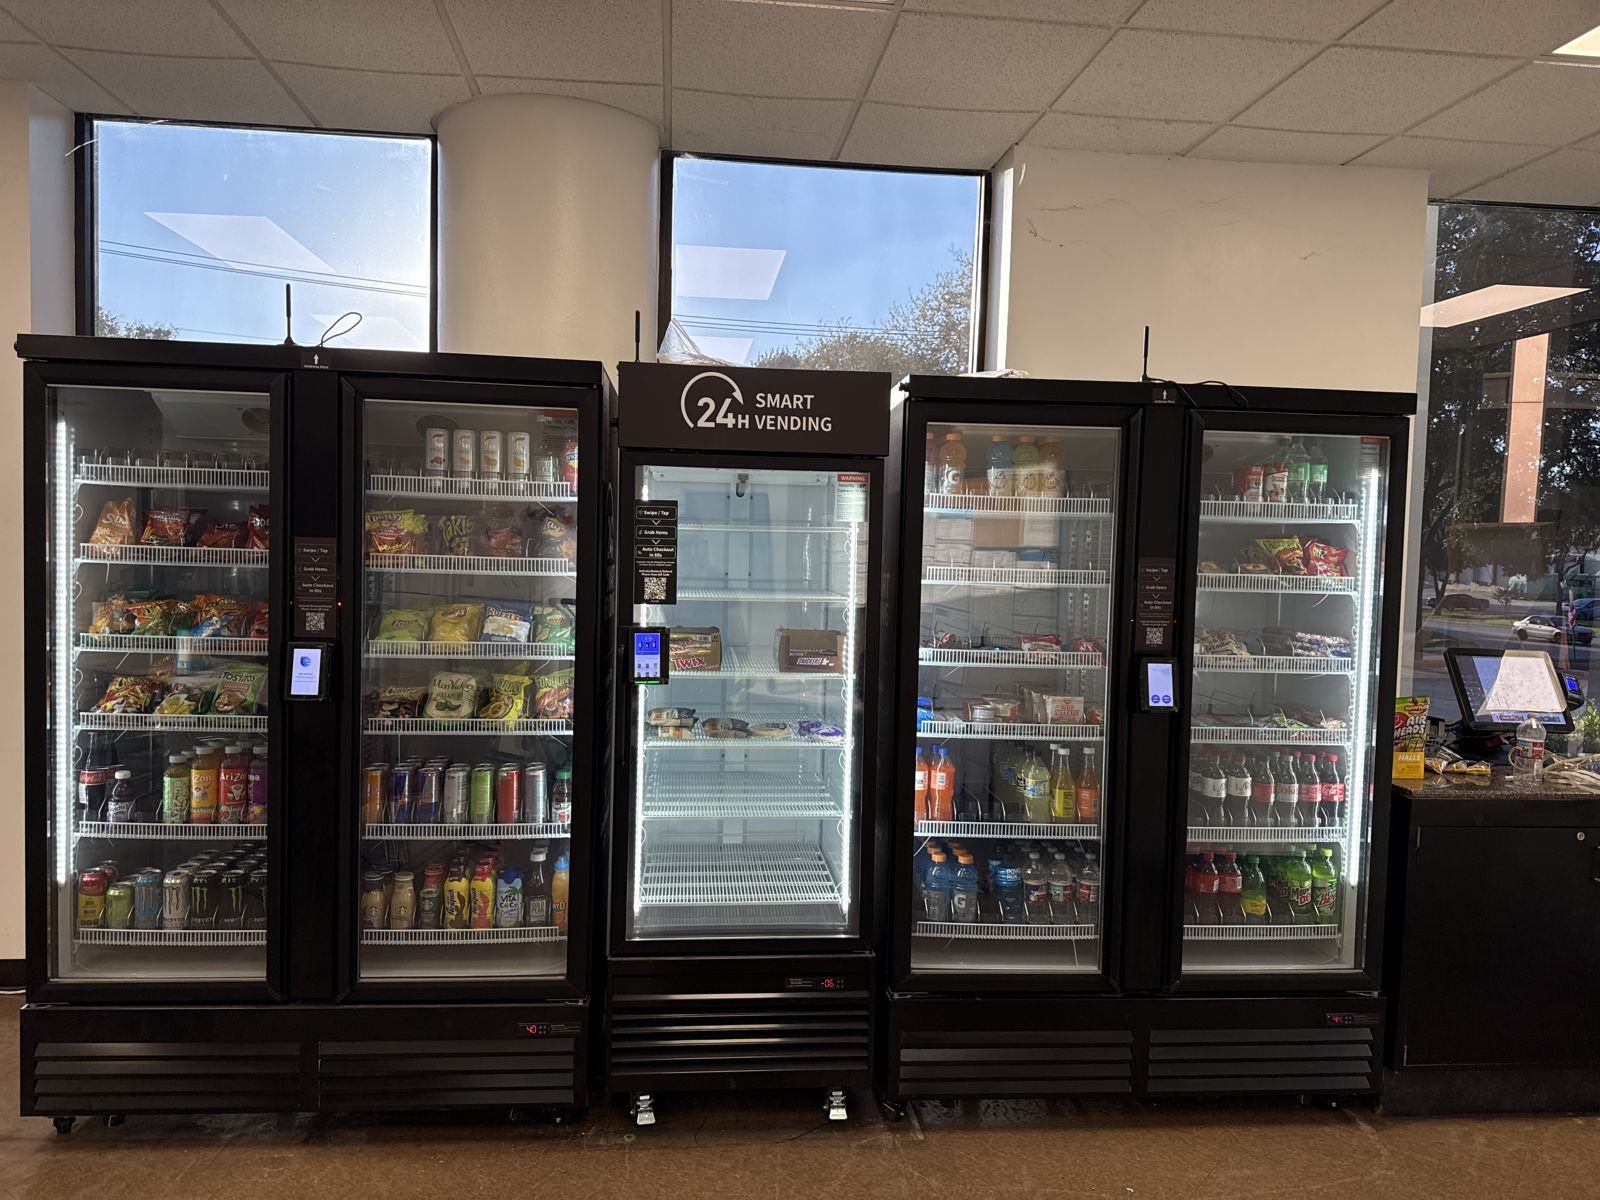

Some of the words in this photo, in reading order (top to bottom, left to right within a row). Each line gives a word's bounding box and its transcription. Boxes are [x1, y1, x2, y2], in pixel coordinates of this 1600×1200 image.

[755, 392, 815, 410] SMART
[697, 397, 750, 429] 24H
[754, 414, 832, 432] VENDING
[1406, 715, 1427, 726] AIR
[1394, 724, 1426, 739] HEADS
[527, 1025, 537, 1034] 40
